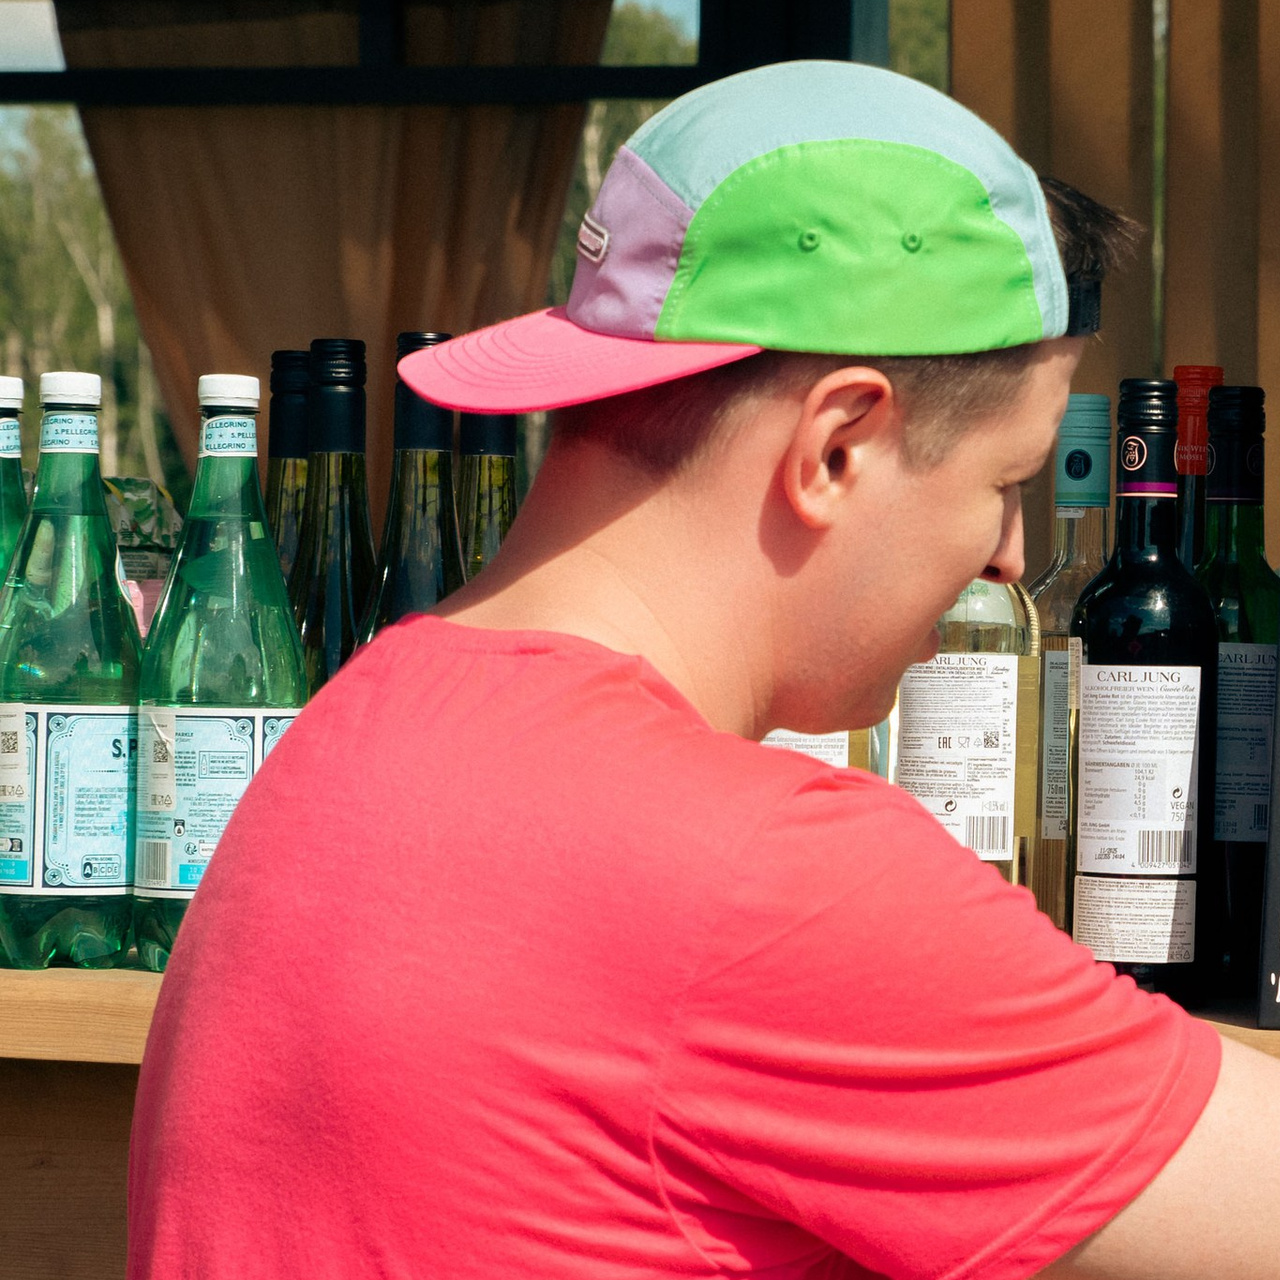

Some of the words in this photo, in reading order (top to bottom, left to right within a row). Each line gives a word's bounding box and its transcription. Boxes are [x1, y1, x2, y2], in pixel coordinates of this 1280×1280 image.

[930, 656, 955, 665] ARL
[958, 657, 987, 666] JUNG
[1097, 670, 1138, 683] CARL
[1140, 671, 1181, 683] JUNG
[1170, 801, 1194, 810] VEGAN
